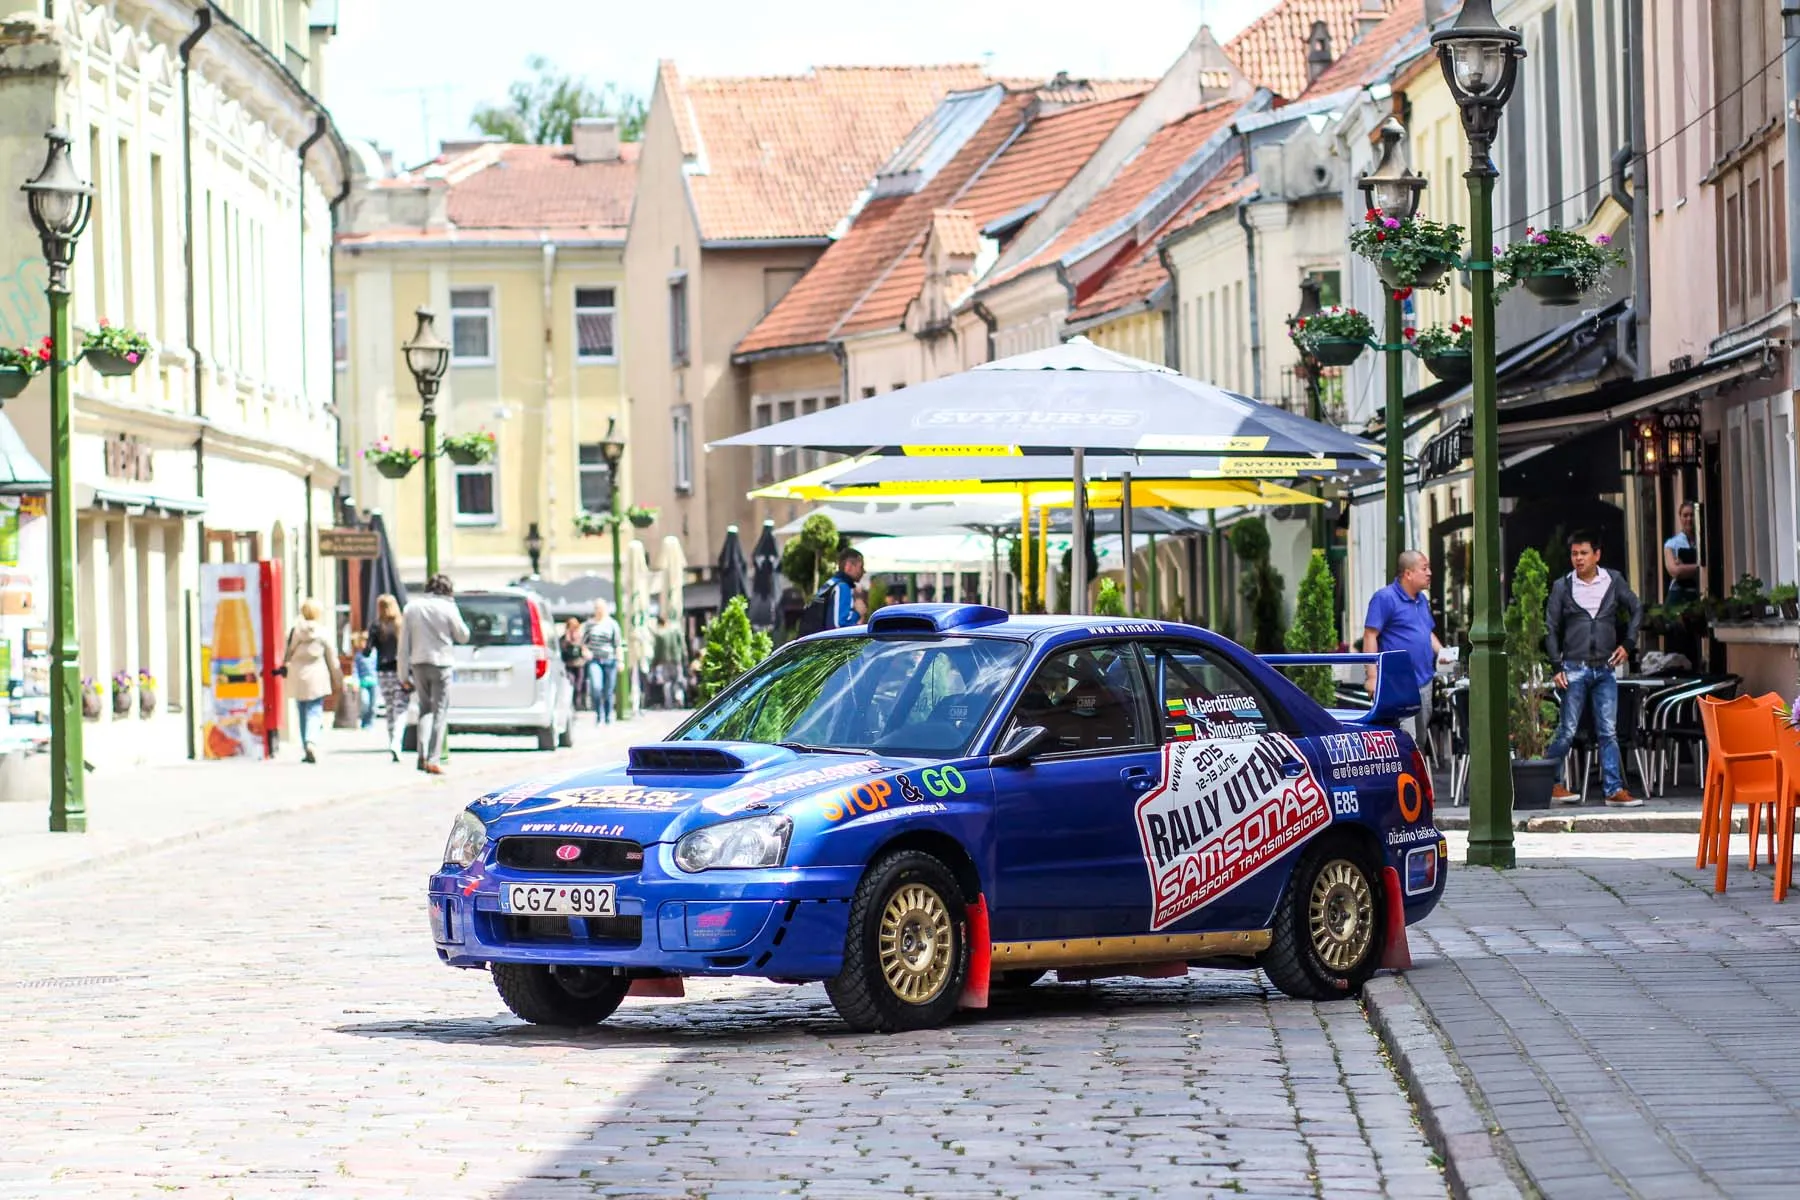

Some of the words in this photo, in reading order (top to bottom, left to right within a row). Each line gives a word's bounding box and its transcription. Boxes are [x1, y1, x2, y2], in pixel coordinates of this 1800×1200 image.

[1087, 623, 1164, 634] www.winart.lt
[1184, 699, 1197, 715] V.
[1197, 695, 1257, 714] Gerdžiūnas
[1195, 727, 1206, 740] A.
[1206, 718, 1256, 739] Šinkūnas
[1192, 744, 1223, 772] 2015
[1333, 758, 1403, 779] autoservisas
[1196, 769, 1218, 791] 12-13
[1219, 753, 1239, 776] JUNE
[819, 779, 892, 821] STOP
[895, 774, 924, 803] &
[921, 765, 967, 797] GO
[1334, 790, 1359, 814] E85
[520, 822, 625, 836] www.winart.lt
[1147, 790, 1222, 868] RALLY
[1388, 829, 1416, 845] Dizaino
[1159, 777, 1319, 909] SAMSONAS
[1157, 867, 1235, 921] MOTORSPORT
[1238, 806, 1325, 872] TRANSMISSIONS
[501, 902, 511, 910] LT
[512, 887, 557, 912] CGZ
[570, 888, 611, 913] 992
